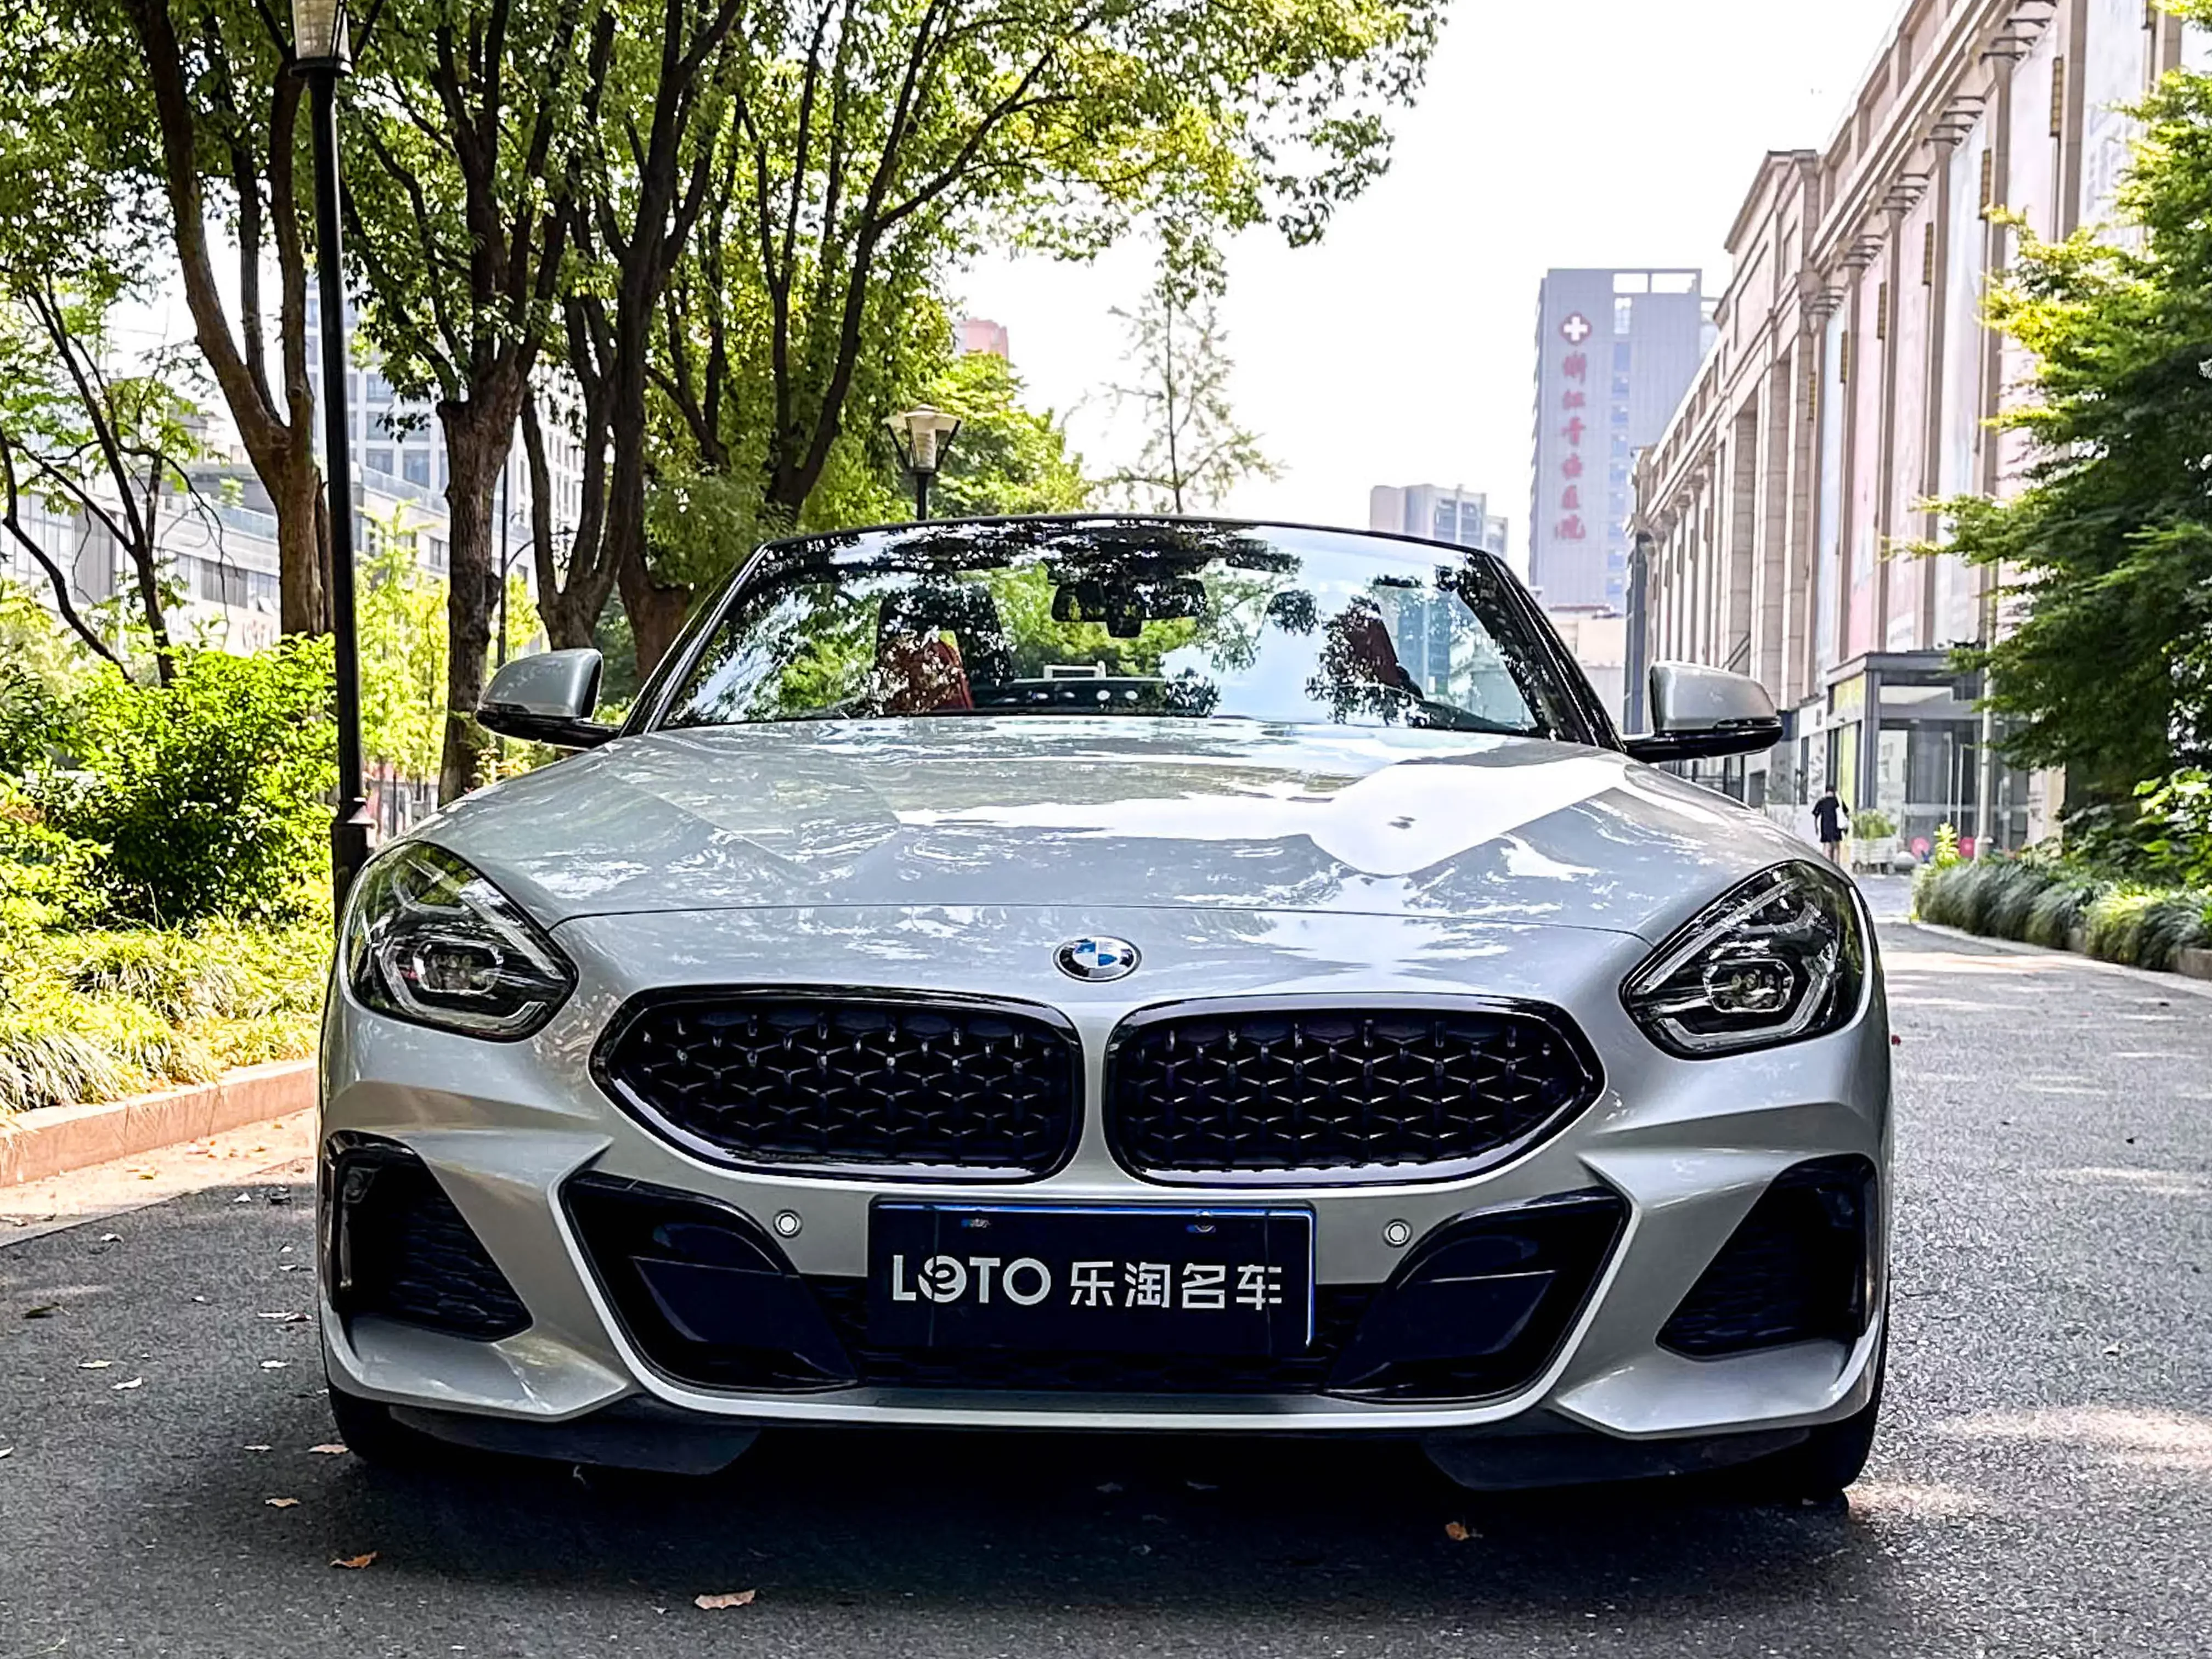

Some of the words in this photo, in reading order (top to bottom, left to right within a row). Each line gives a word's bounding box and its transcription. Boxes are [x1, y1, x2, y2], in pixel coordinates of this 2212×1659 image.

[893, 1254, 1051, 1306] LOTO
[1070, 1261, 1282, 1311] 乐淘名车
